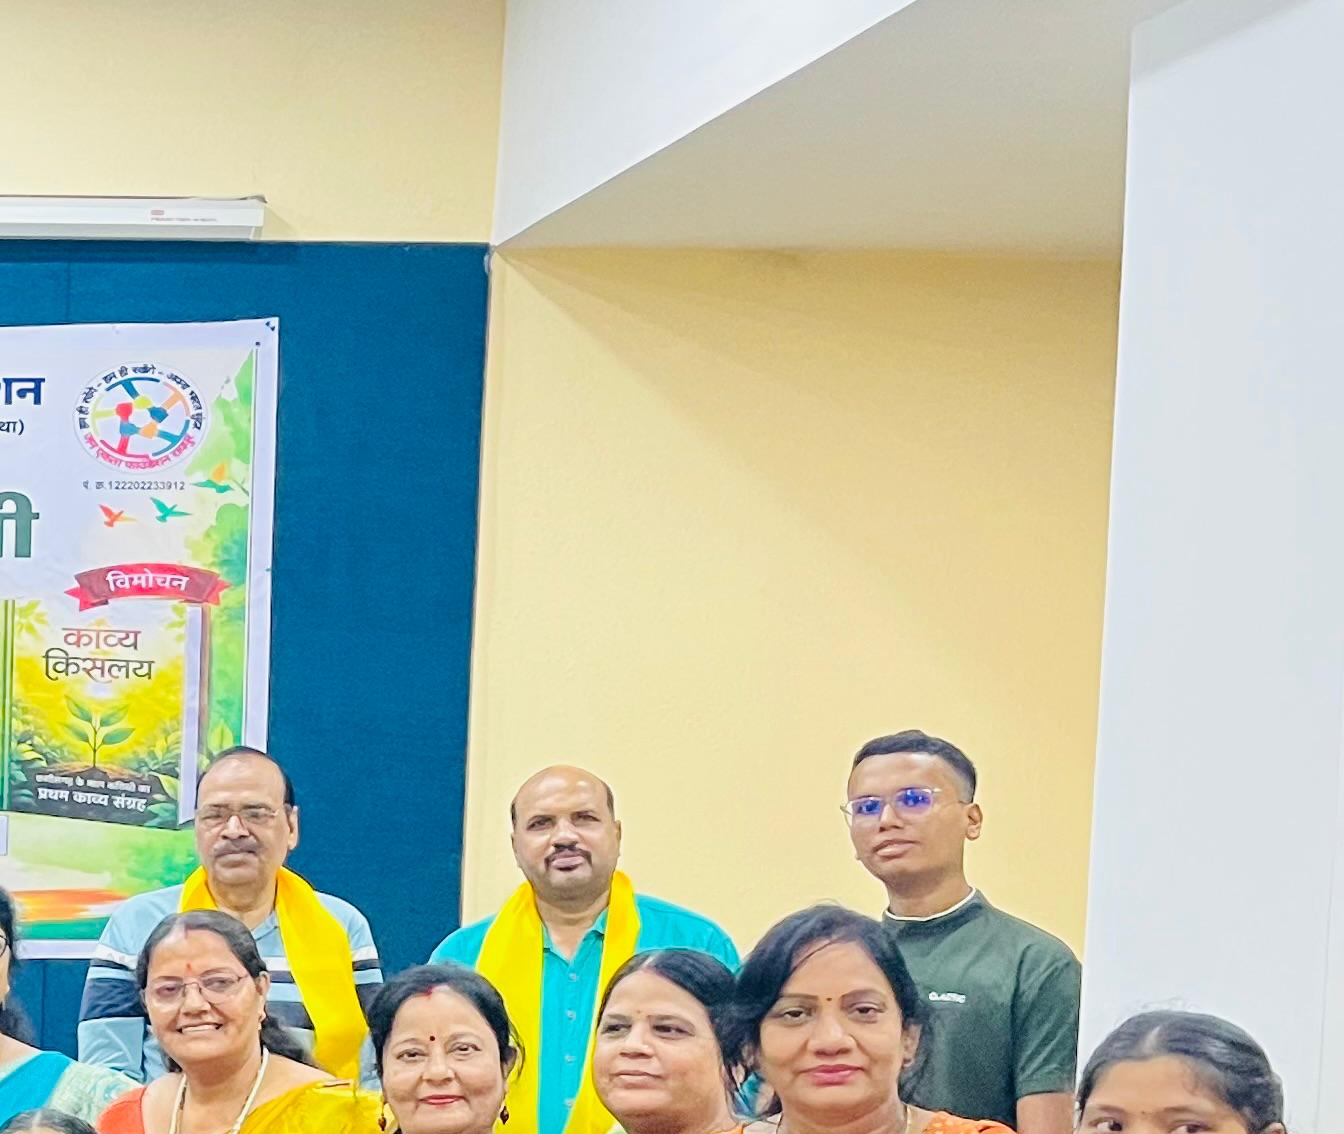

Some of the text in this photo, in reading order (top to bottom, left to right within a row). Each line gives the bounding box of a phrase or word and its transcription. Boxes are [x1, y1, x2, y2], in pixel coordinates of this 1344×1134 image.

[105, 568, 190, 591] विमोचन
[62, 627, 142, 650] काव्य
[43, 647, 155, 683] किसलय
[37, 787, 147, 812] प्रथम काव्य संग्रह
